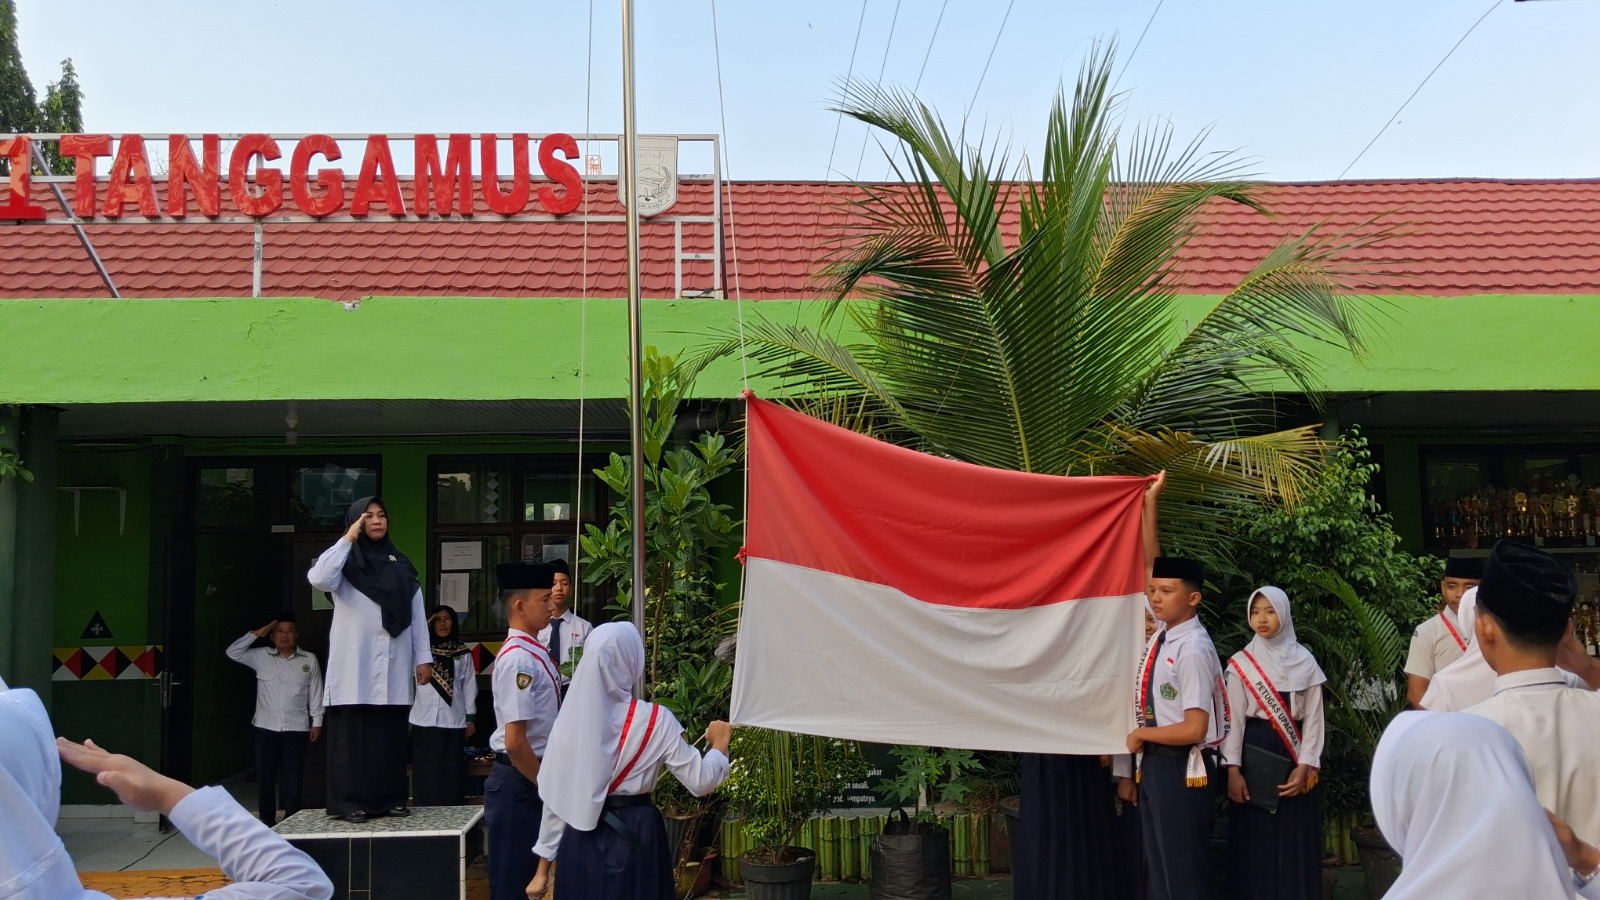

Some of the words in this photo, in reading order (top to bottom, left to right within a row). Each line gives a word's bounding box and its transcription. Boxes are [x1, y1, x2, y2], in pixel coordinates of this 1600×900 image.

[0, 135, 46, 220] 1
[59, 133, 584, 218] TANGGAMUS
[1256, 680, 1281, 714] PETUGAS
[1278, 713, 1299, 747] UPACARA
